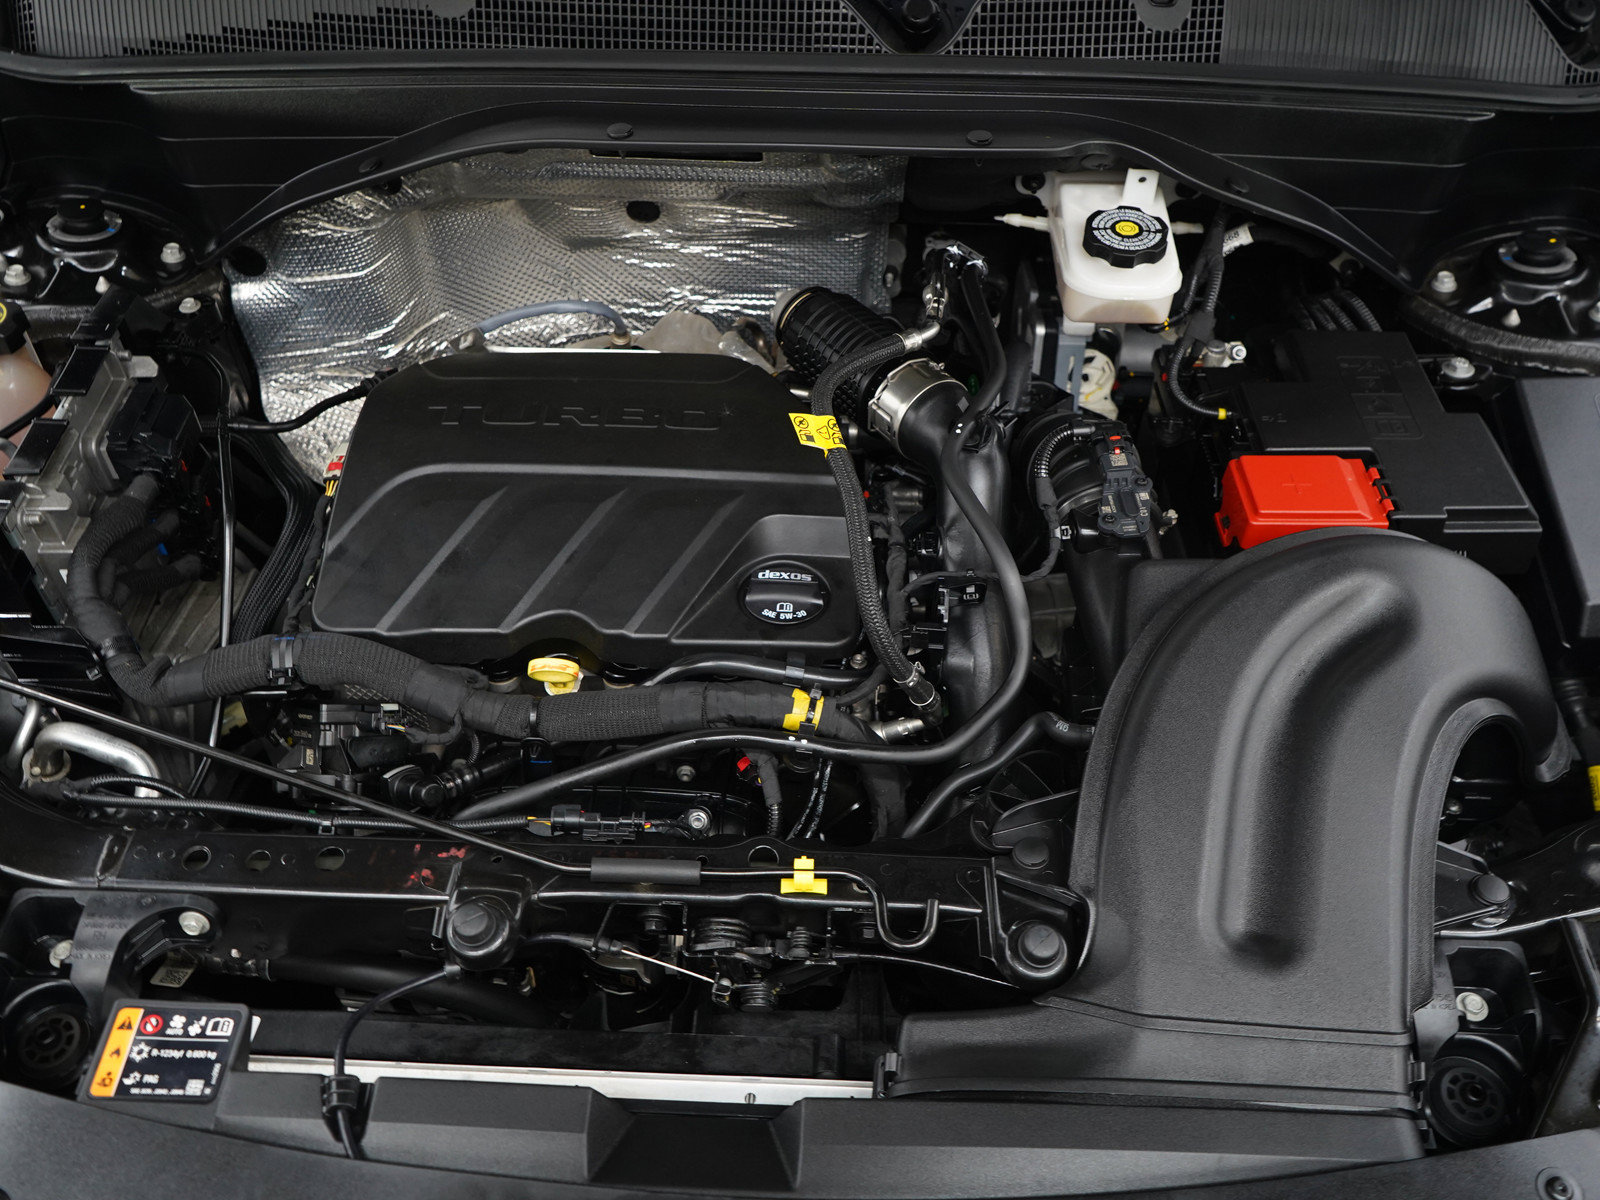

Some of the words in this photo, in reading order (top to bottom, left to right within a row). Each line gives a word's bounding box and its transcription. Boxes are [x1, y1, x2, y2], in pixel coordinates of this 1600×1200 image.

[428, 405, 720, 431] TURBO
[757, 570, 813, 582] dexos
[761, 608, 778, 619] SAE
[779, 609, 808, 620] 5W-30
